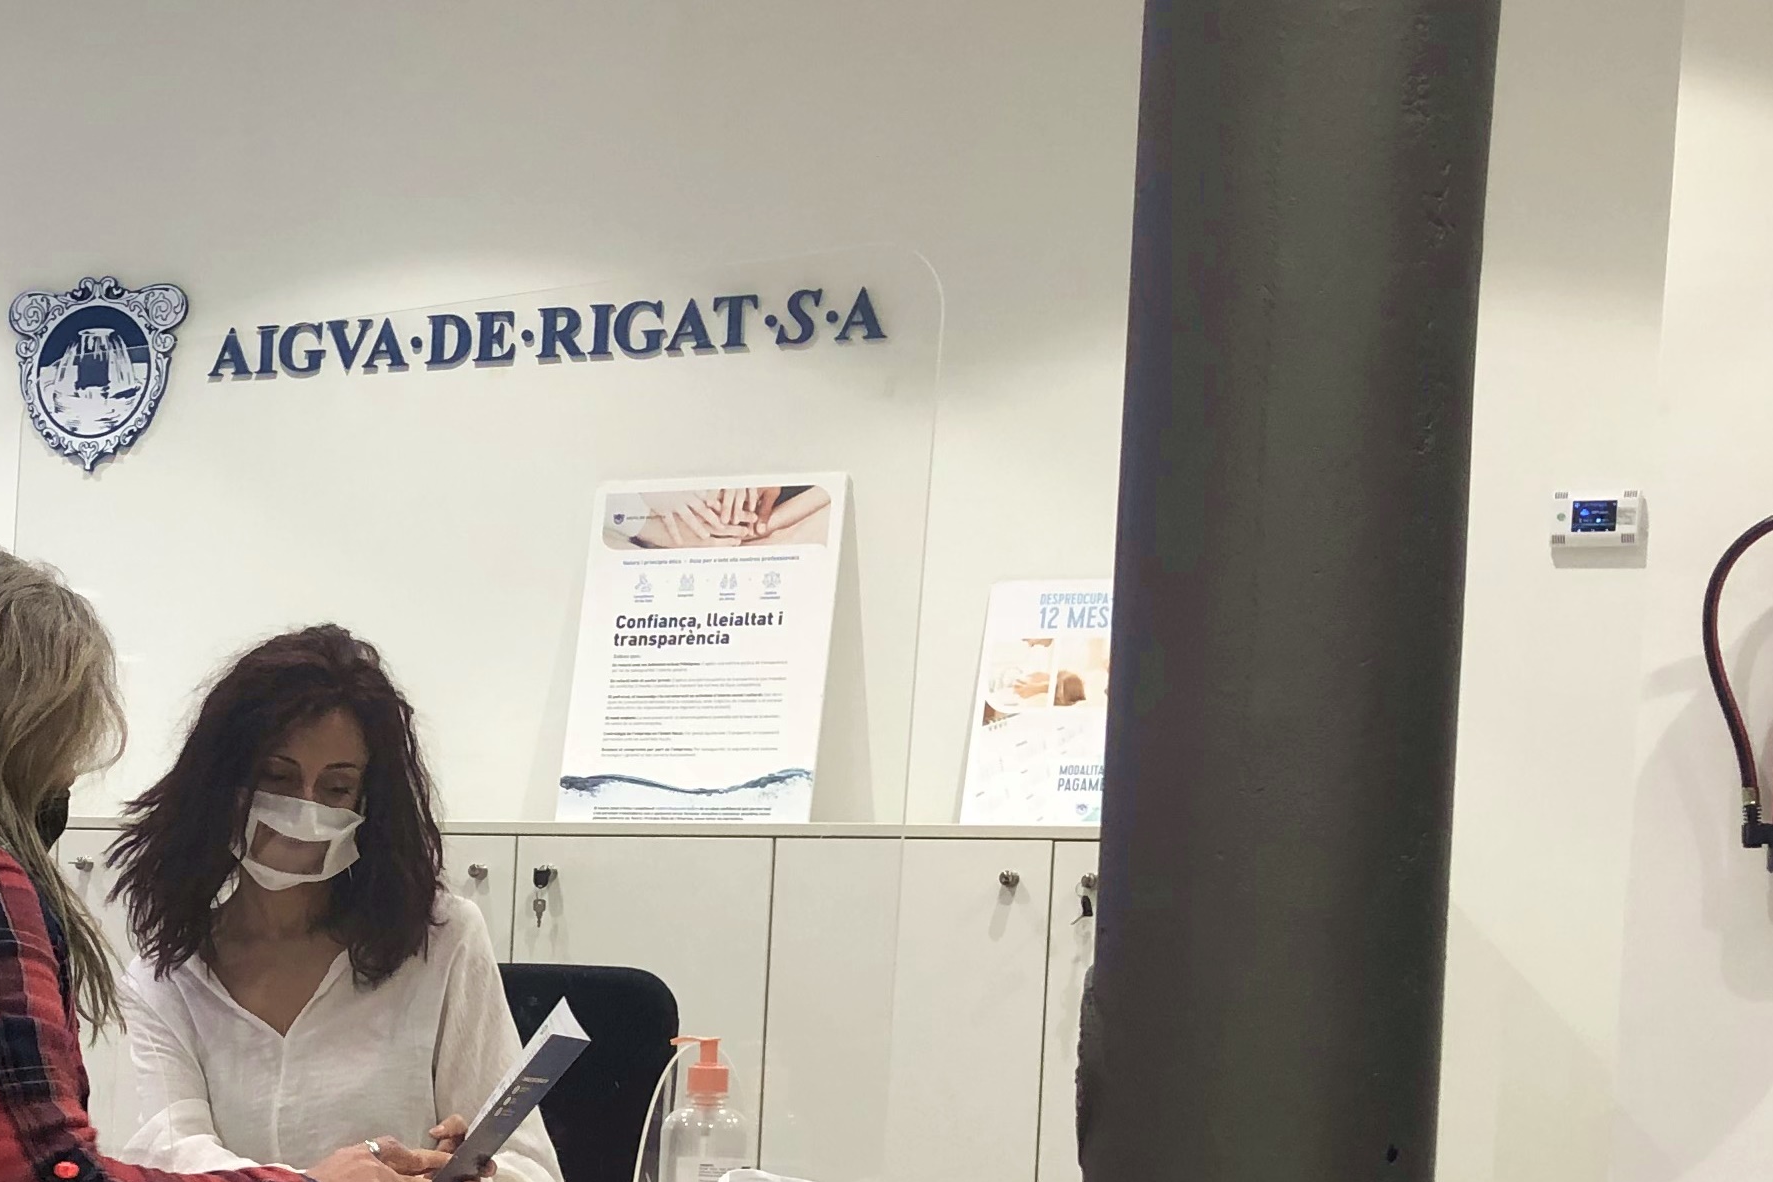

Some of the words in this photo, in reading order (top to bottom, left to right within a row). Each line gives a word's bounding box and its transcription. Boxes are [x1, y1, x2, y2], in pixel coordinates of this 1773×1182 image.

[1039, 592, 1112, 605] DESPREOCUPA
[615, 614, 702, 631] Confiança,
[706, 611, 774, 627] lleialtat
[777, 611, 784, 626] i
[1039, 606, 1060, 629] 12
[1067, 605, 1110, 629] MES
[613, 629, 730, 649] transparència
